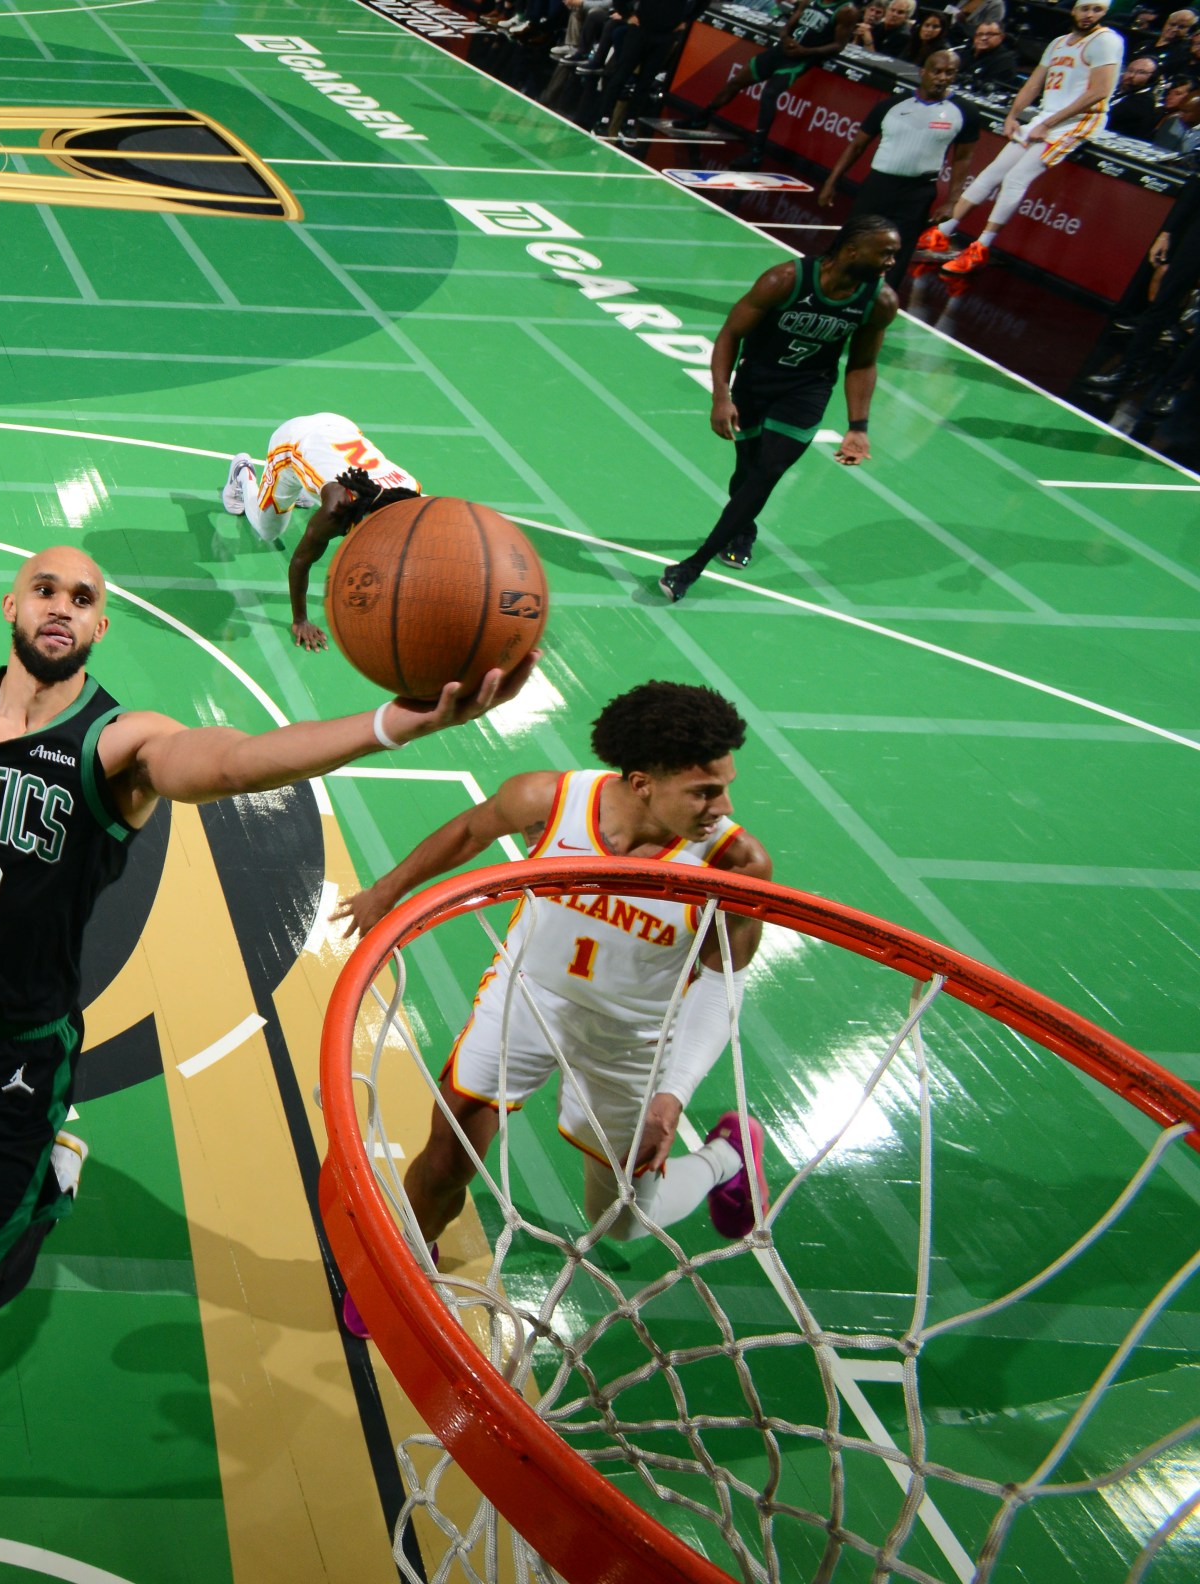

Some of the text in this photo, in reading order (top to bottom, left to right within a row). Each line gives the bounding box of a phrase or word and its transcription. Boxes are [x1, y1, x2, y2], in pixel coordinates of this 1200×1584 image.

[1045, 71, 1065, 90] 22
[277, 54, 430, 141] GARDEN
[808, 106, 861, 142] pace
[525, 241, 737, 396] GARD
[778, 339, 822, 367] 7
[331, 440, 380, 471] 2
[372, 470, 407, 490] WALL
[29, 744, 76, 768] Amica
[546, 894, 677, 947] LANTA
[566, 935, 599, 982] 1
